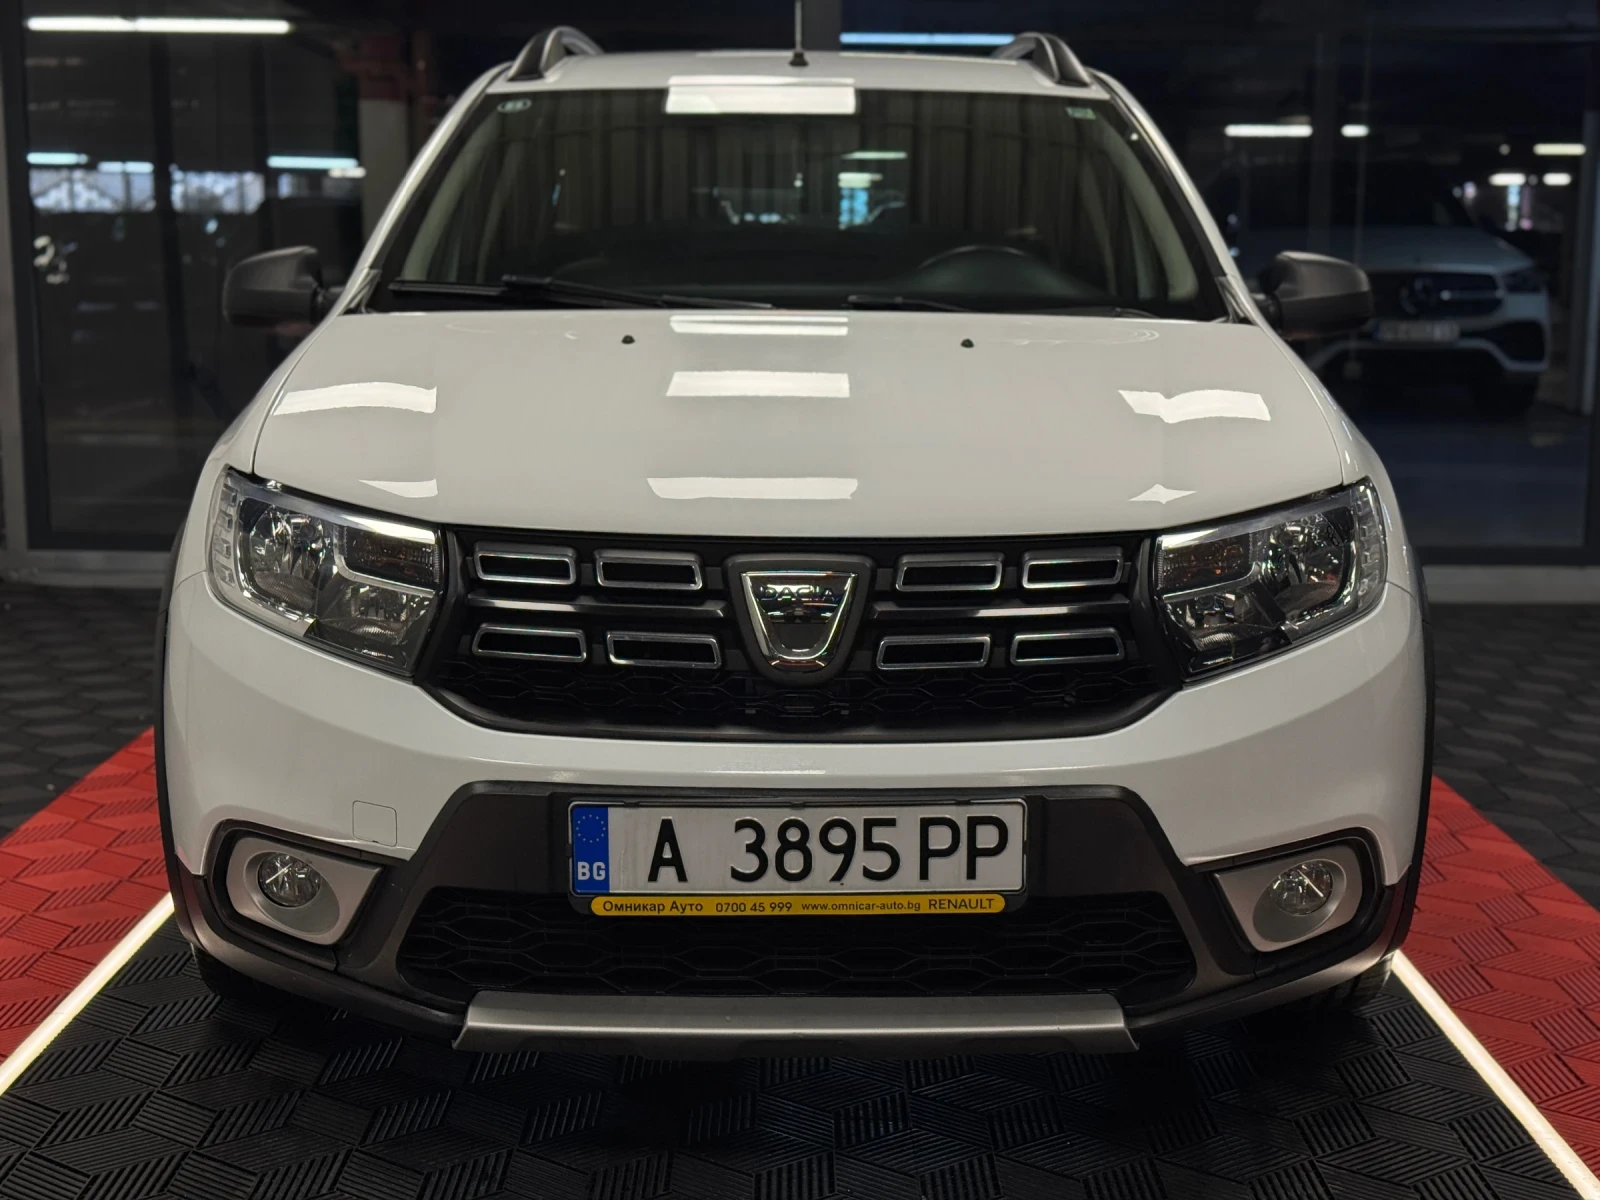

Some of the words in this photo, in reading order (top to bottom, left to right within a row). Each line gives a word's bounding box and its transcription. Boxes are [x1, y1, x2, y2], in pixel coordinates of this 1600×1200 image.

[759, 585, 835, 602] DACIA
[647, 816, 688, 883] A
[730, 816, 901, 883] 3895
[577, 861, 606, 881] BG
[602, 900, 665, 915] Омникар
[669, 900, 704, 915] Ауто
[715, 902, 747, 913] 0700
[749, 901, 766, 912] 45
[769, 901, 793, 912] 999
[801, 899, 921, 912] www.omnicar-auto.bg
[928, 898, 995, 910] RENAULT
